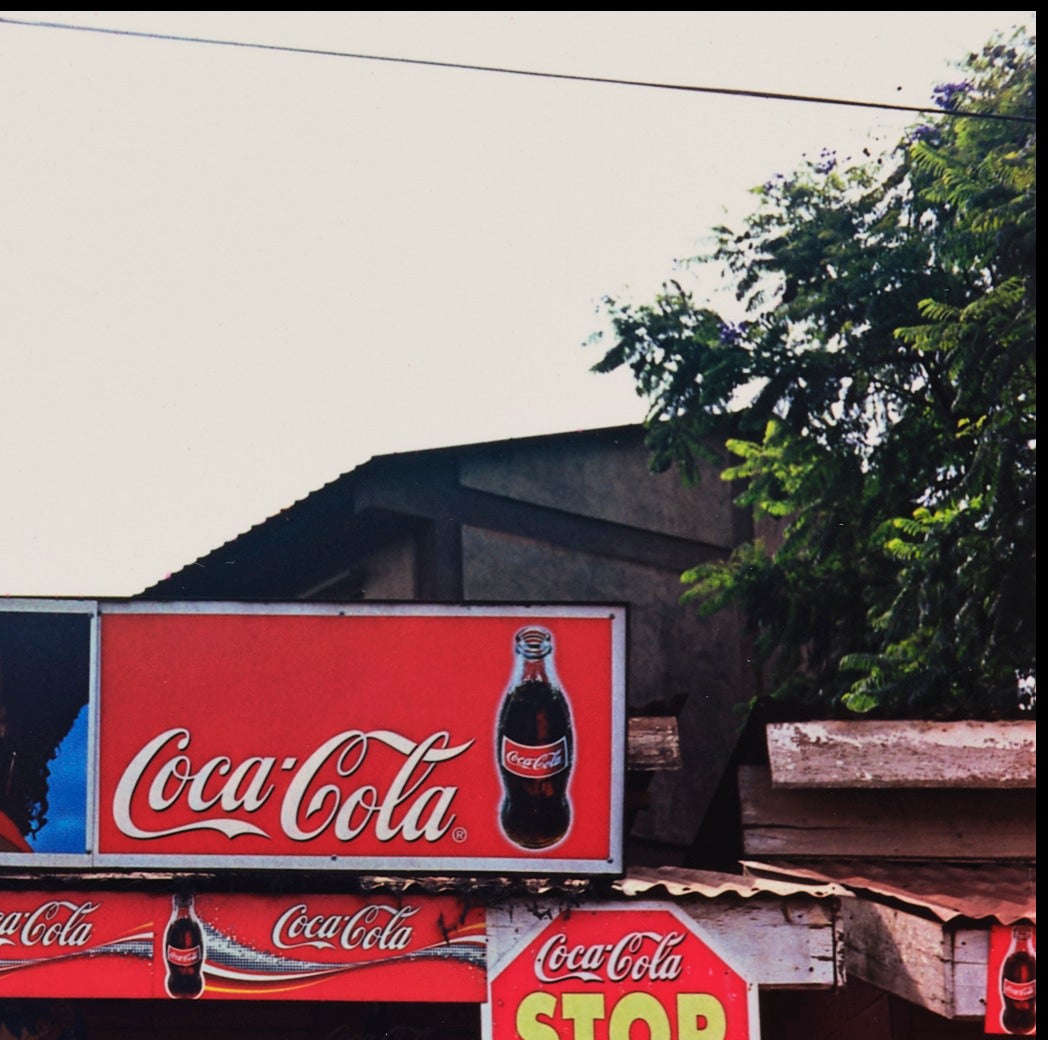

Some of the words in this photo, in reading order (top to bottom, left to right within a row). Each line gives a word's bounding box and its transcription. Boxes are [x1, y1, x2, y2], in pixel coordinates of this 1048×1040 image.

[505, 749, 562, 770] Coca-Cola
[113, 729, 476, 842] Coca-Cola
[271, 903, 422, 951] Coca-Cola
[533, 931, 688, 983] Coca-Cola
